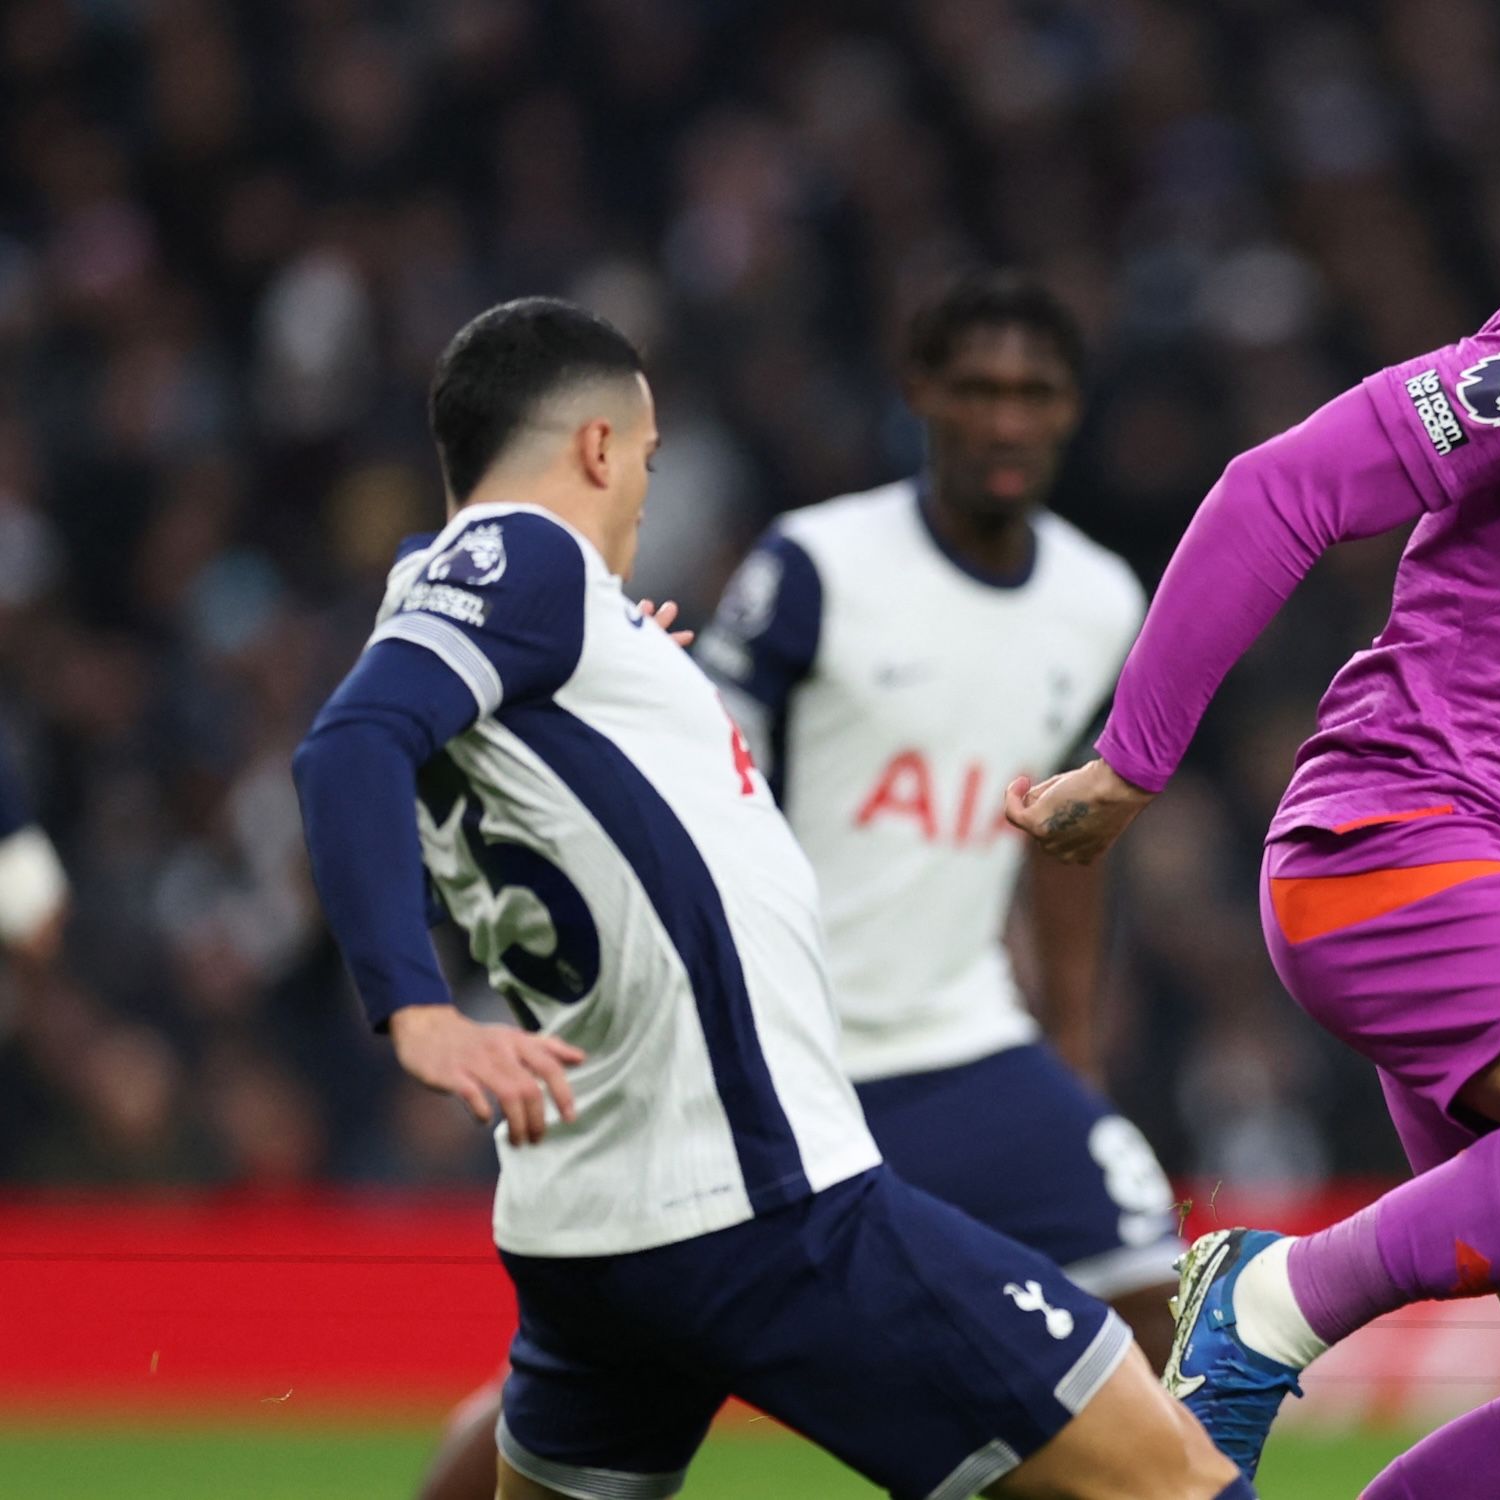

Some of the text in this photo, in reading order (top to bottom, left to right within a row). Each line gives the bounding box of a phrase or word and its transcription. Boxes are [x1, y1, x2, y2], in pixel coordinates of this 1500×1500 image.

[1414, 396, 1453, 457] racism
[1419, 368, 1463, 442] No room
